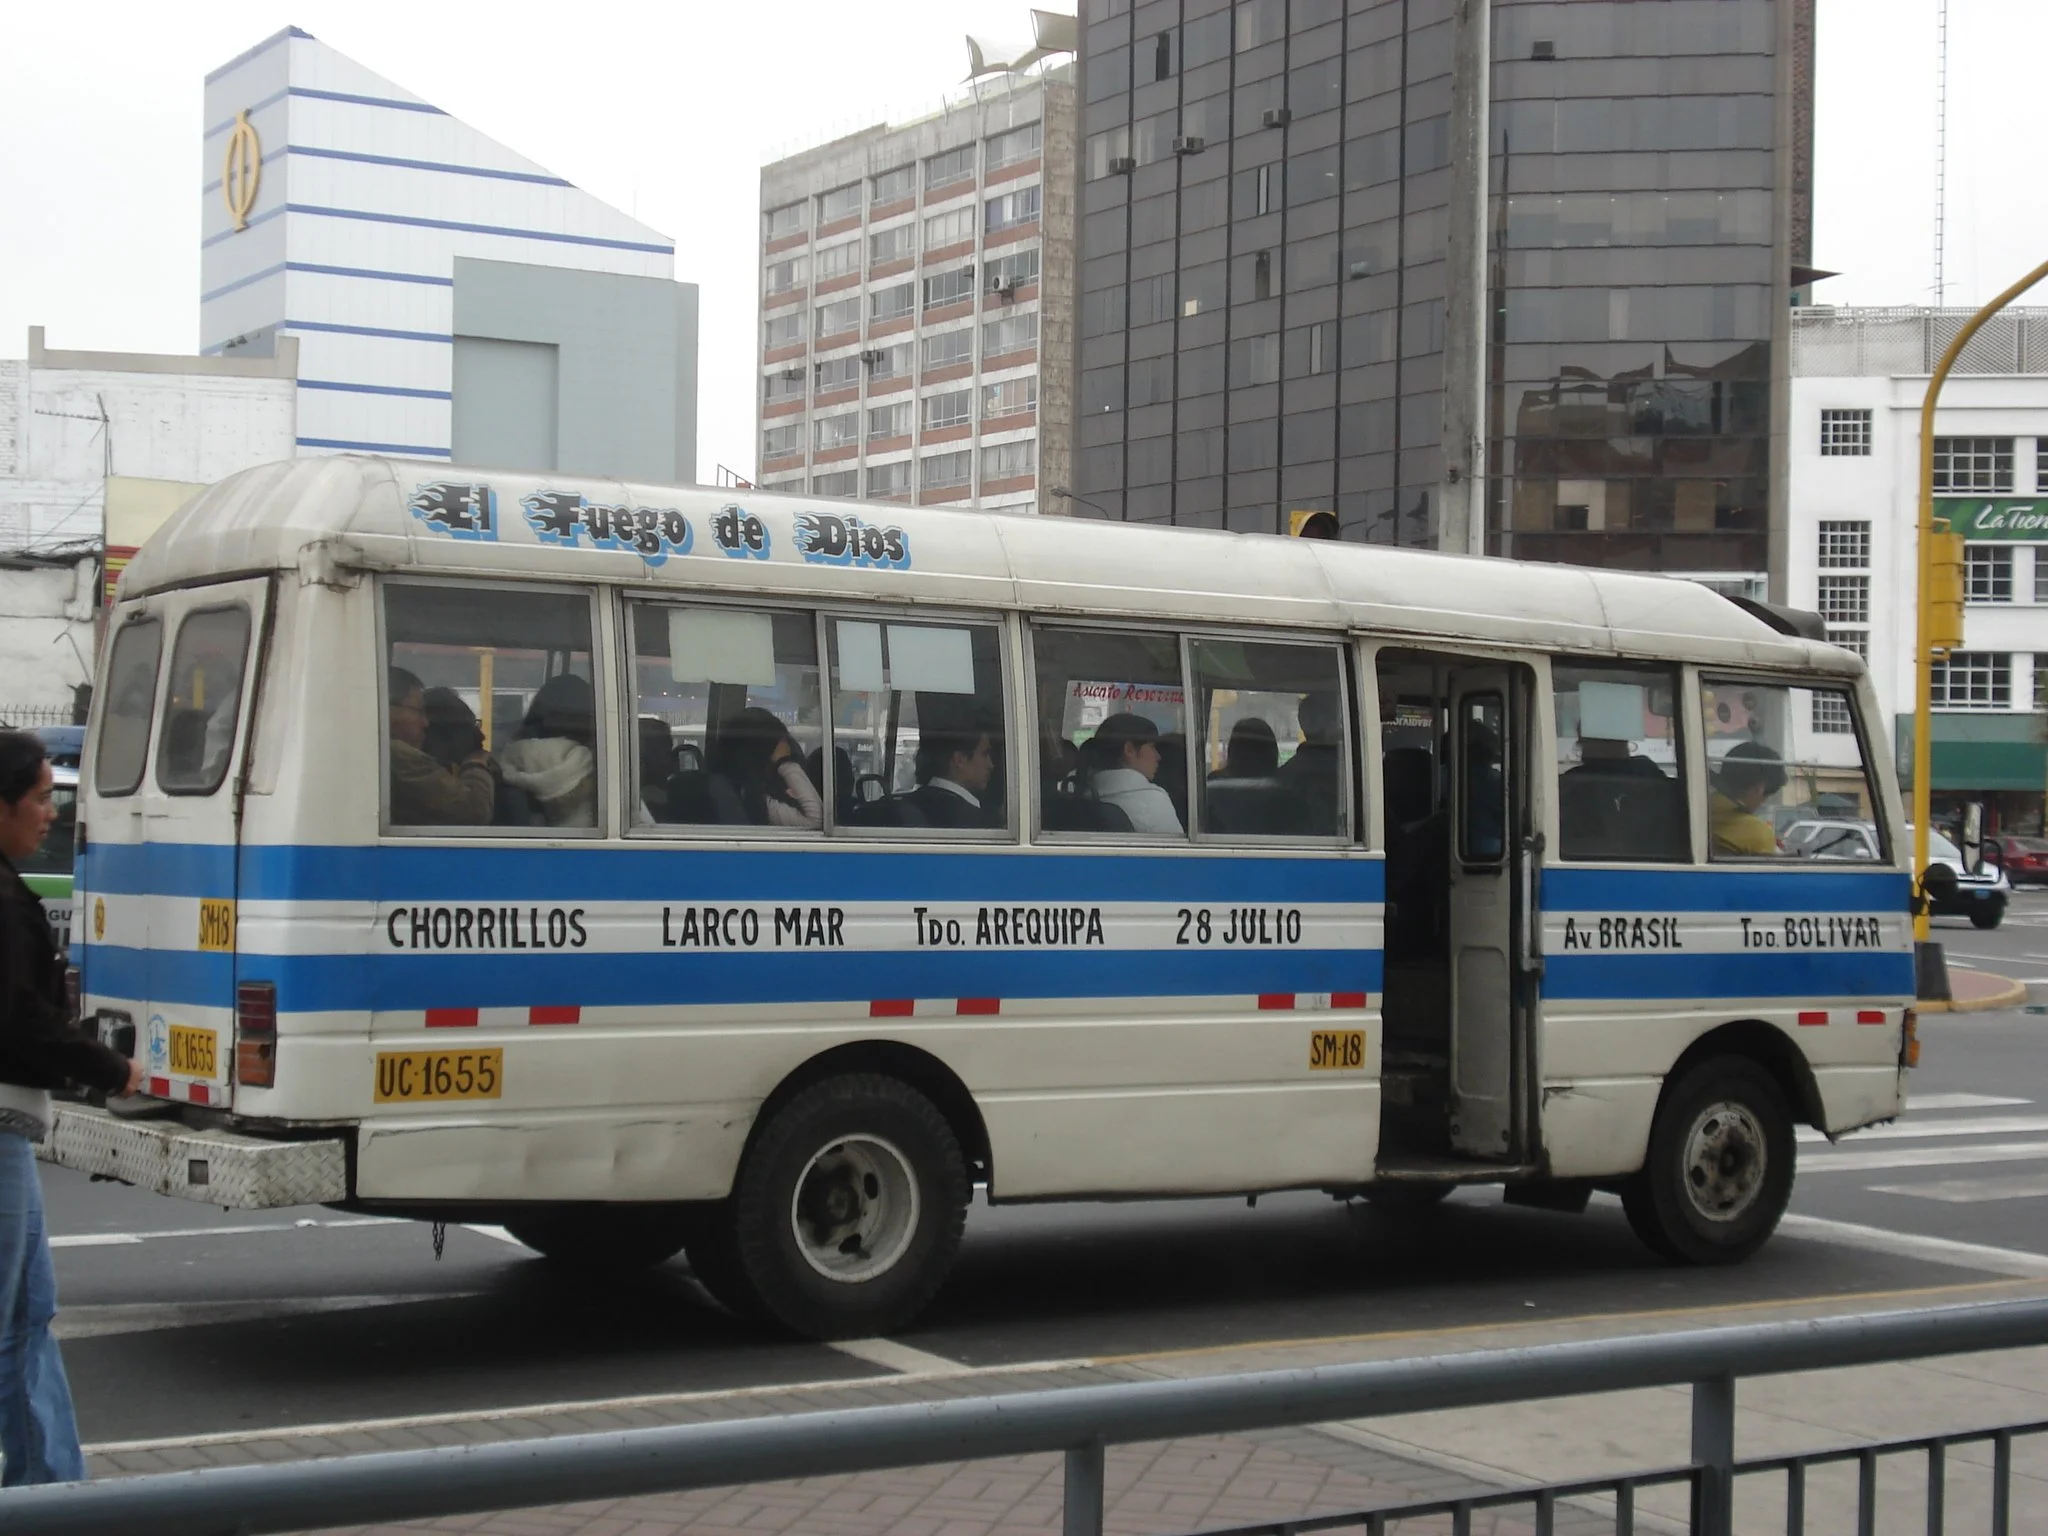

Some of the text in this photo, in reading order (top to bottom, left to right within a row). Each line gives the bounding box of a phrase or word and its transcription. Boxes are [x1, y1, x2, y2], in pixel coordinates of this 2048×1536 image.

[408, 482, 905, 562] El Fuego de Dios
[387, 907, 587, 949] CHORRILLOS
[662, 907, 760, 947] LARCO
[774, 907, 845, 947] MAR
[975, 907, 1105, 946] AREQUIPA
[1176, 909, 1212, 944] 28
[1223, 909, 1302, 945] JULIO
[1599, 917, 1683, 949] BRASIL
[1784, 917, 1882, 948] BOLIVAR
